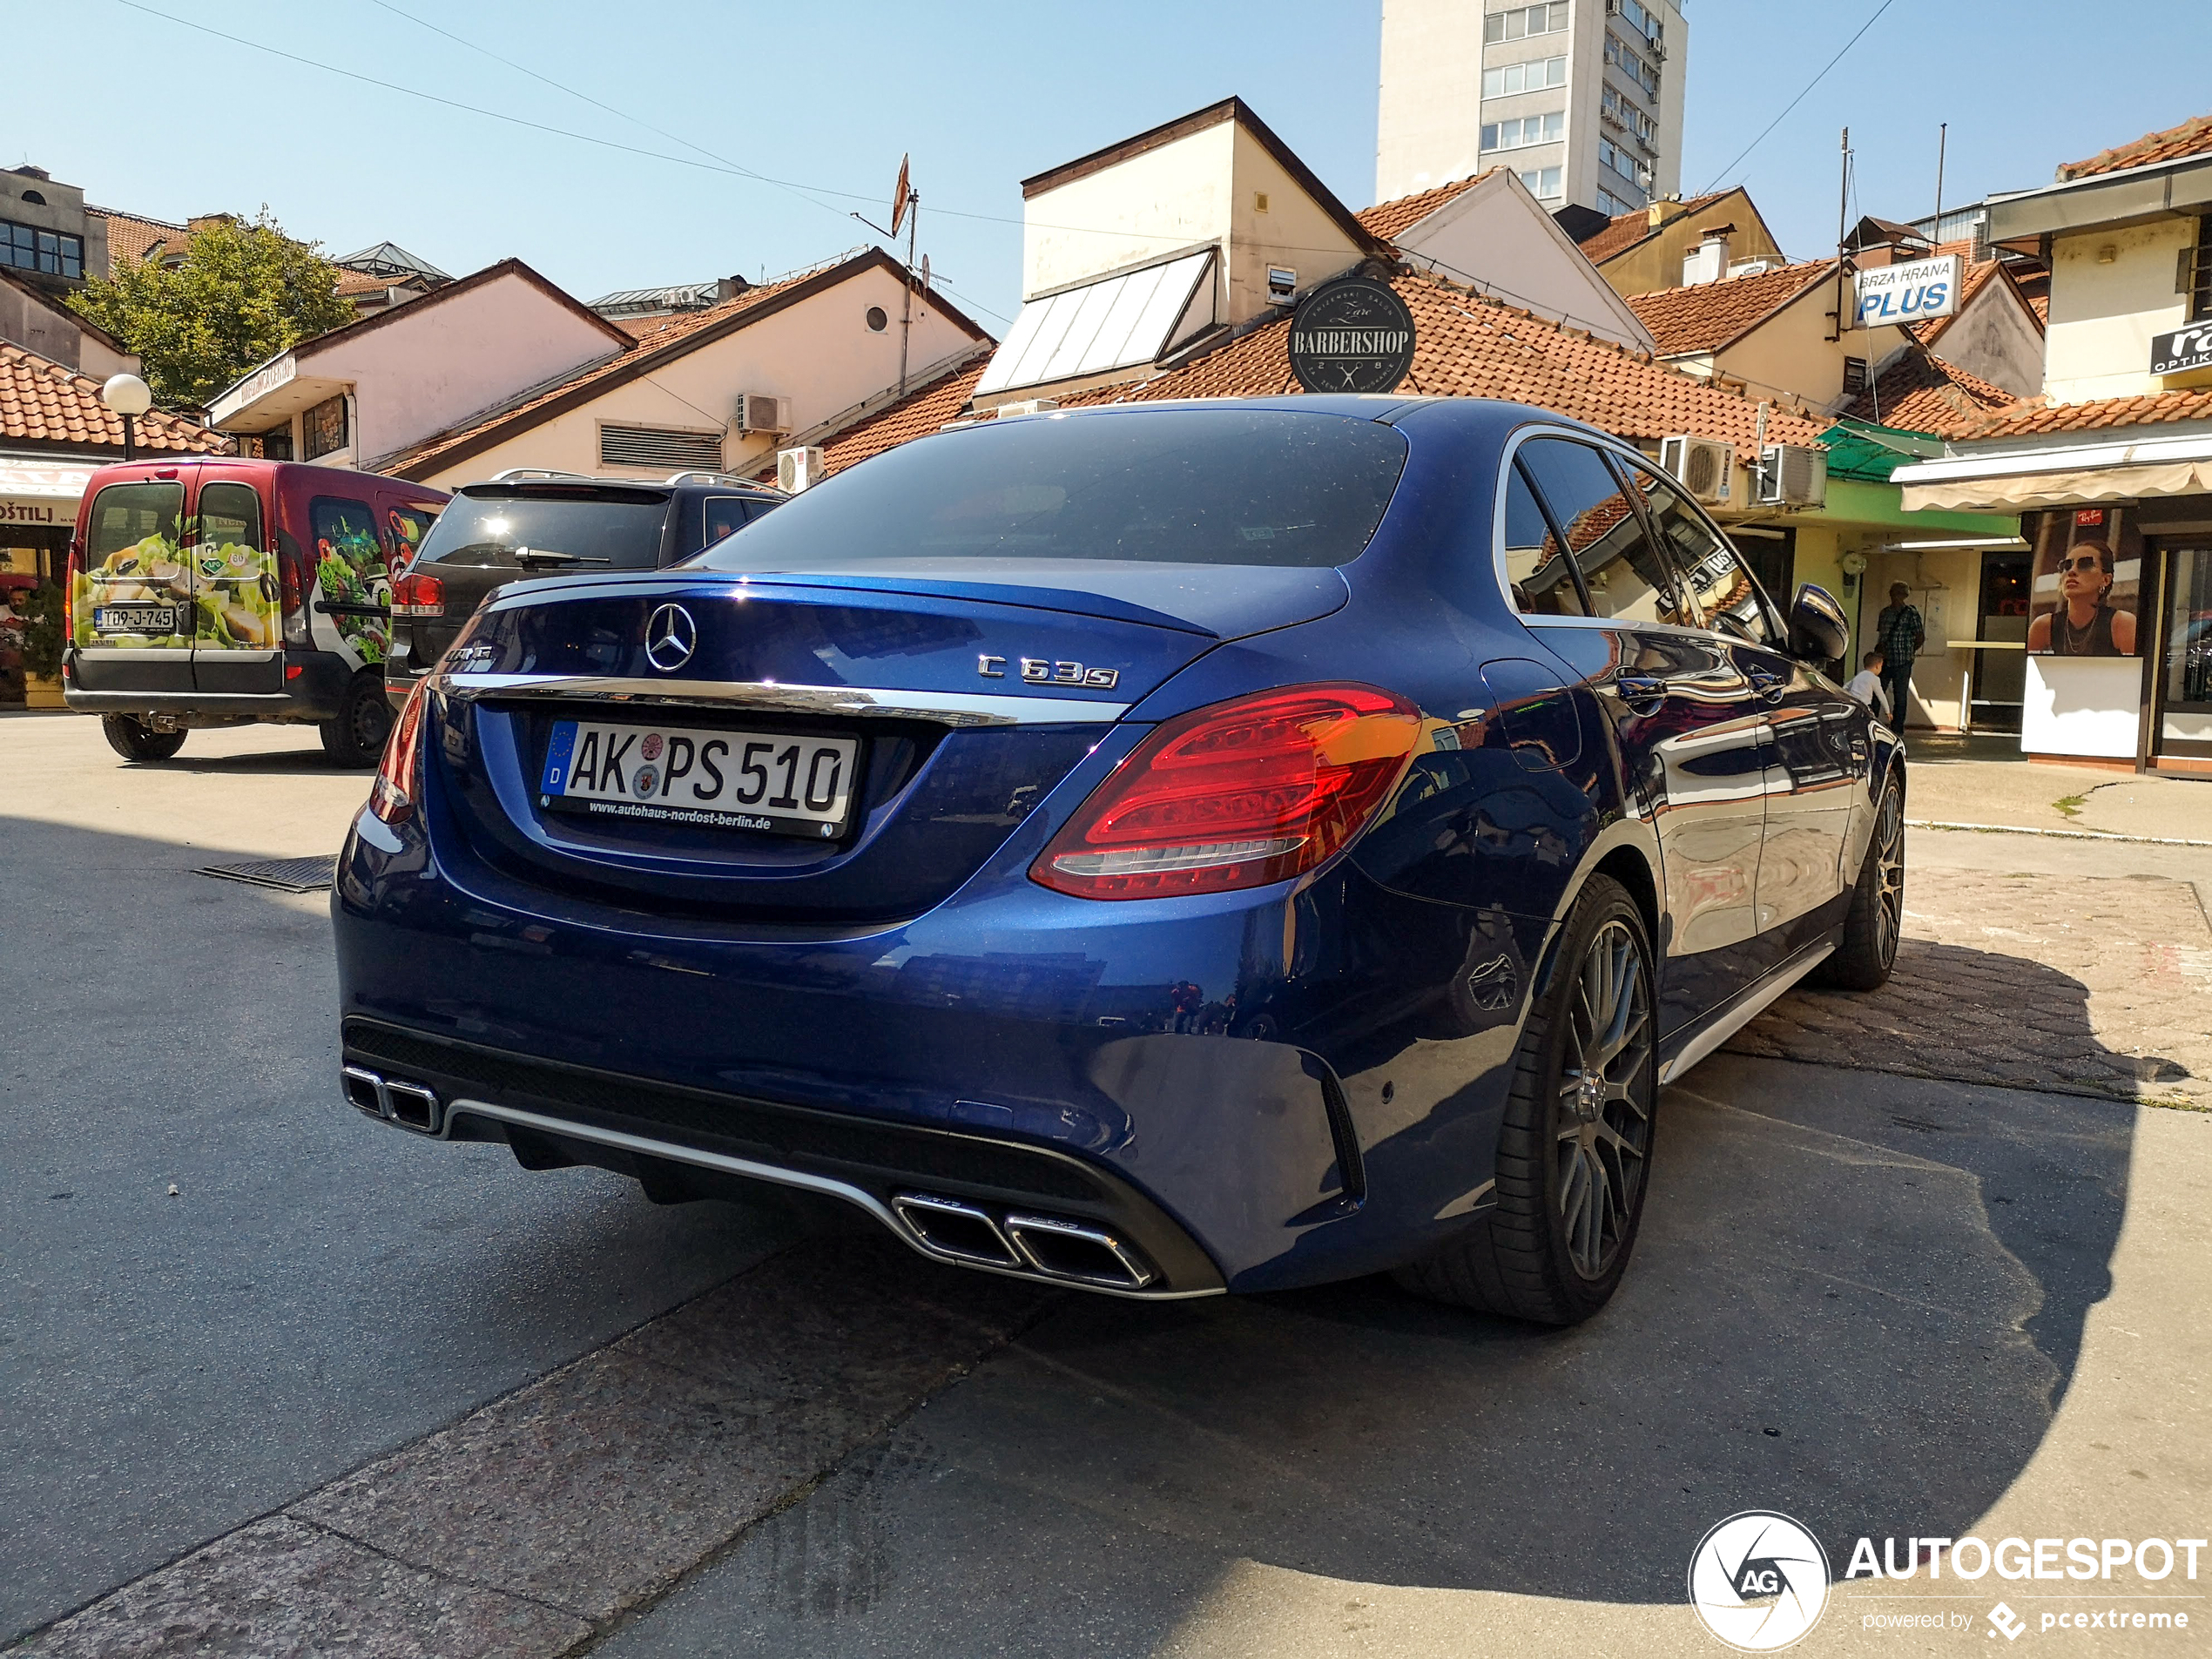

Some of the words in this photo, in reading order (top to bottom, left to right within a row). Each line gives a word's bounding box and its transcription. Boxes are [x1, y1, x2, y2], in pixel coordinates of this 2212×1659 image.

[1859, 272, 1895, 289] BRZA
[1900, 262, 1950, 282] HRANA
[1858, 282, 1948, 320] PLUS
[1294, 331, 1409, 354] BARBERSHOP
[271, 357, 293, 387] CENTAR
[2155, 353, 2212, 372] OPTIK
[105, 610, 171, 625] T09-J-745
[978, 655, 1006, 677] C
[570, 732, 637, 793] AK
[550, 767, 560, 784] D
[590, 802, 772, 830] www.autohaus-nordost-berlin.de
